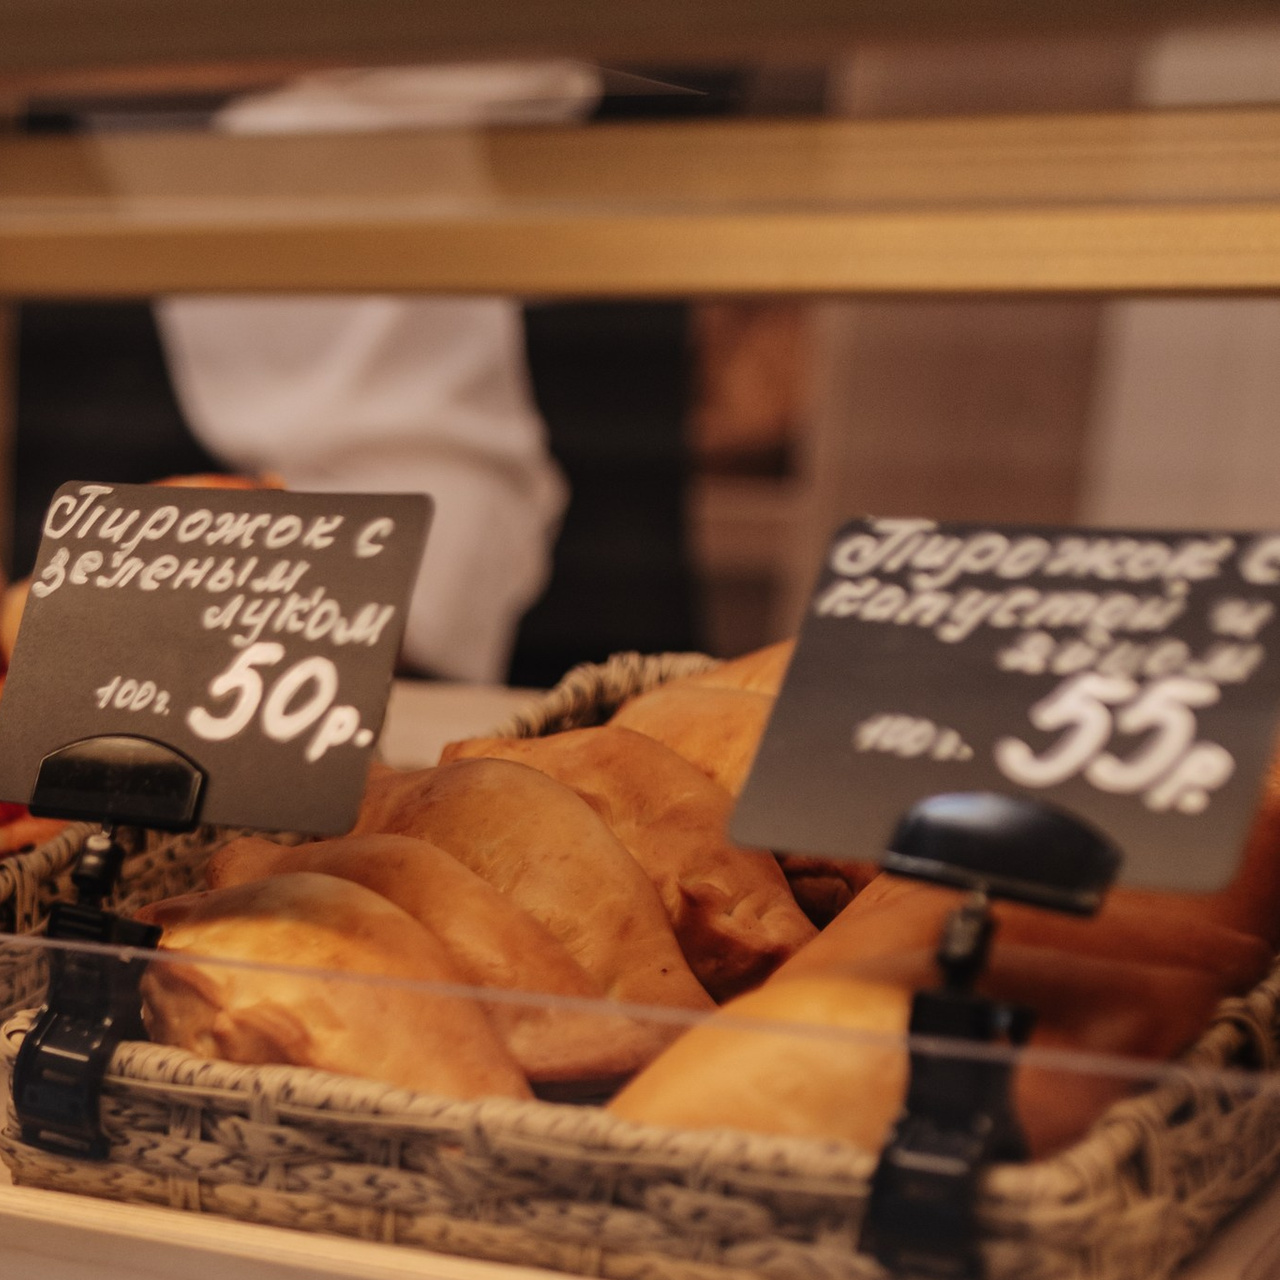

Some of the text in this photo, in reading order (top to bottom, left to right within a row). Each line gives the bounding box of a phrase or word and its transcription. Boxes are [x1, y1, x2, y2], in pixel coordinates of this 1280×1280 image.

[42, 484, 394, 560] Пирожок с
[829, 516, 1237, 592] Пирожок
[31, 546, 311, 600] зеленым
[200, 586, 396, 648] луком
[1211, 598, 1274, 637] и
[187, 641, 376, 763] 50р.
